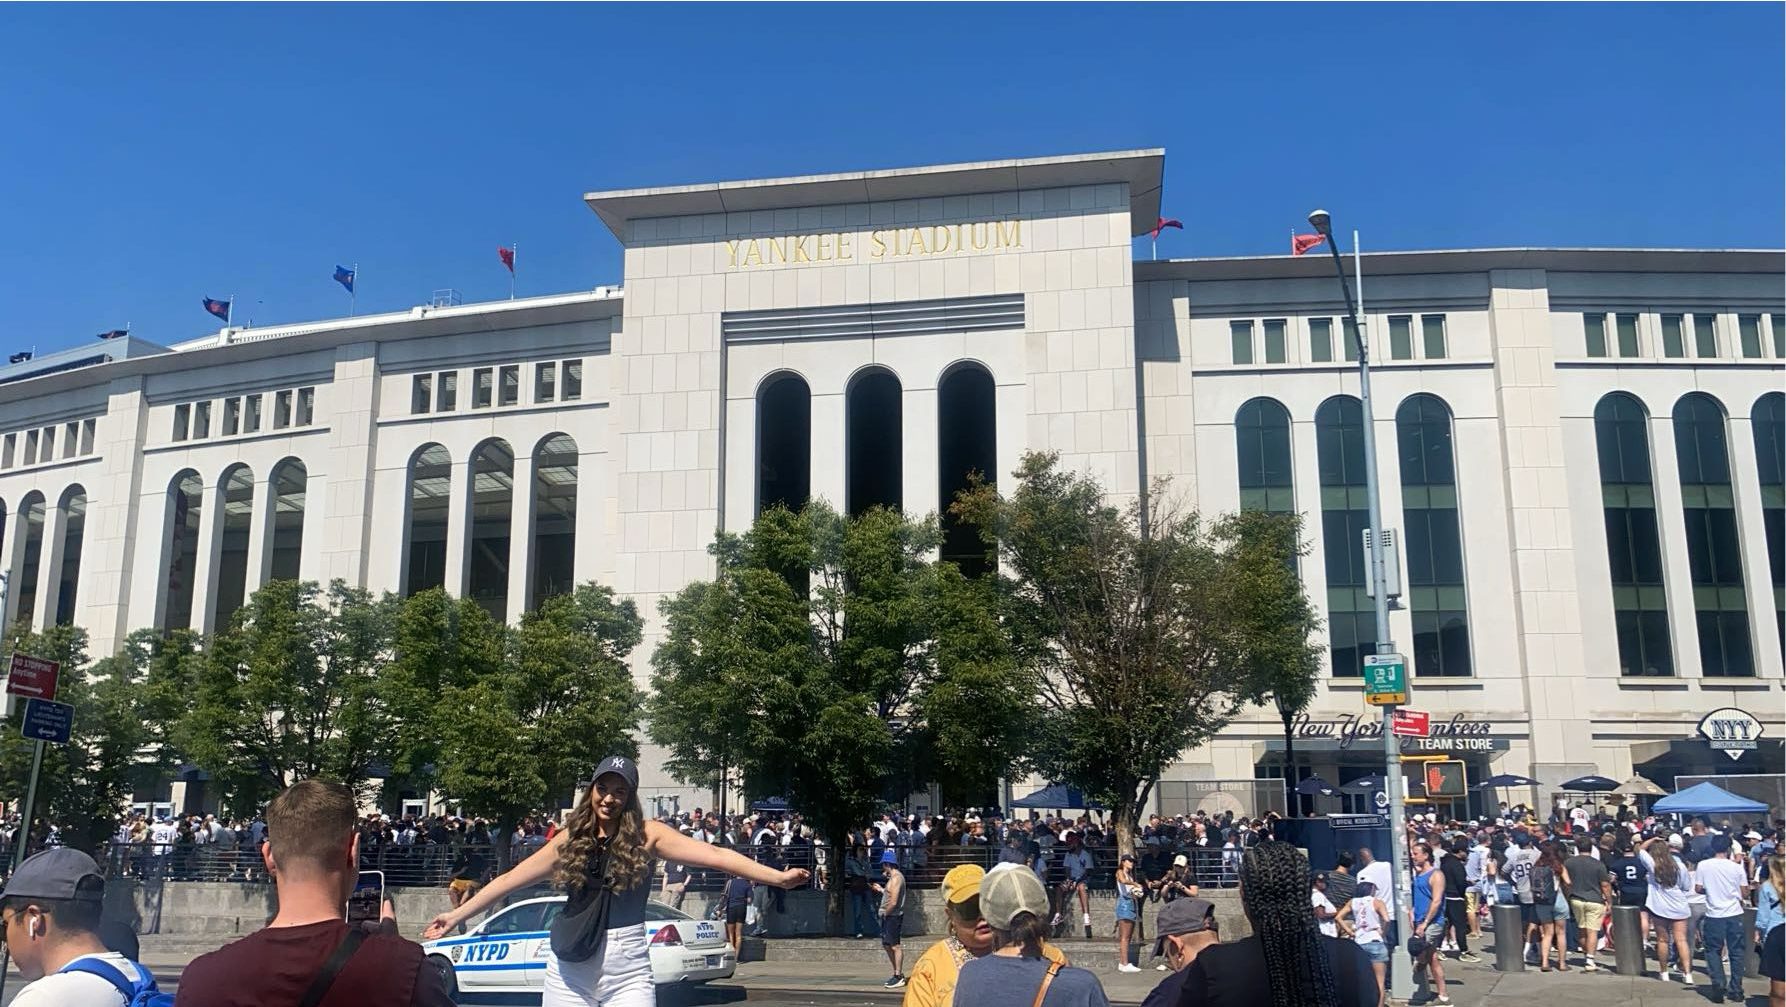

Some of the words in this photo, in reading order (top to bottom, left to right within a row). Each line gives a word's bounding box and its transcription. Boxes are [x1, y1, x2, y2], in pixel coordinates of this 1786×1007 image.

[725, 232, 853, 268] YANKEE
[870, 219, 1025, 259] STADIUM
[1291, 713, 1336, 737] New
[1336, 713, 1385, 749] Yor
[1711, 719, 1752, 739] NYY
[1418, 738, 1452, 750] TEAM
[1456, 738, 1493, 750] STORE
[1195, 782, 1218, 791] TEAM
[1219, 782, 1245, 791] STORE
[157, 832, 168, 841] 24
[1626, 866, 1637, 880] 2
[697, 924, 714, 932] NYPD
[696, 932, 719, 940] POLICE
[464, 943, 510, 962] NYPD
